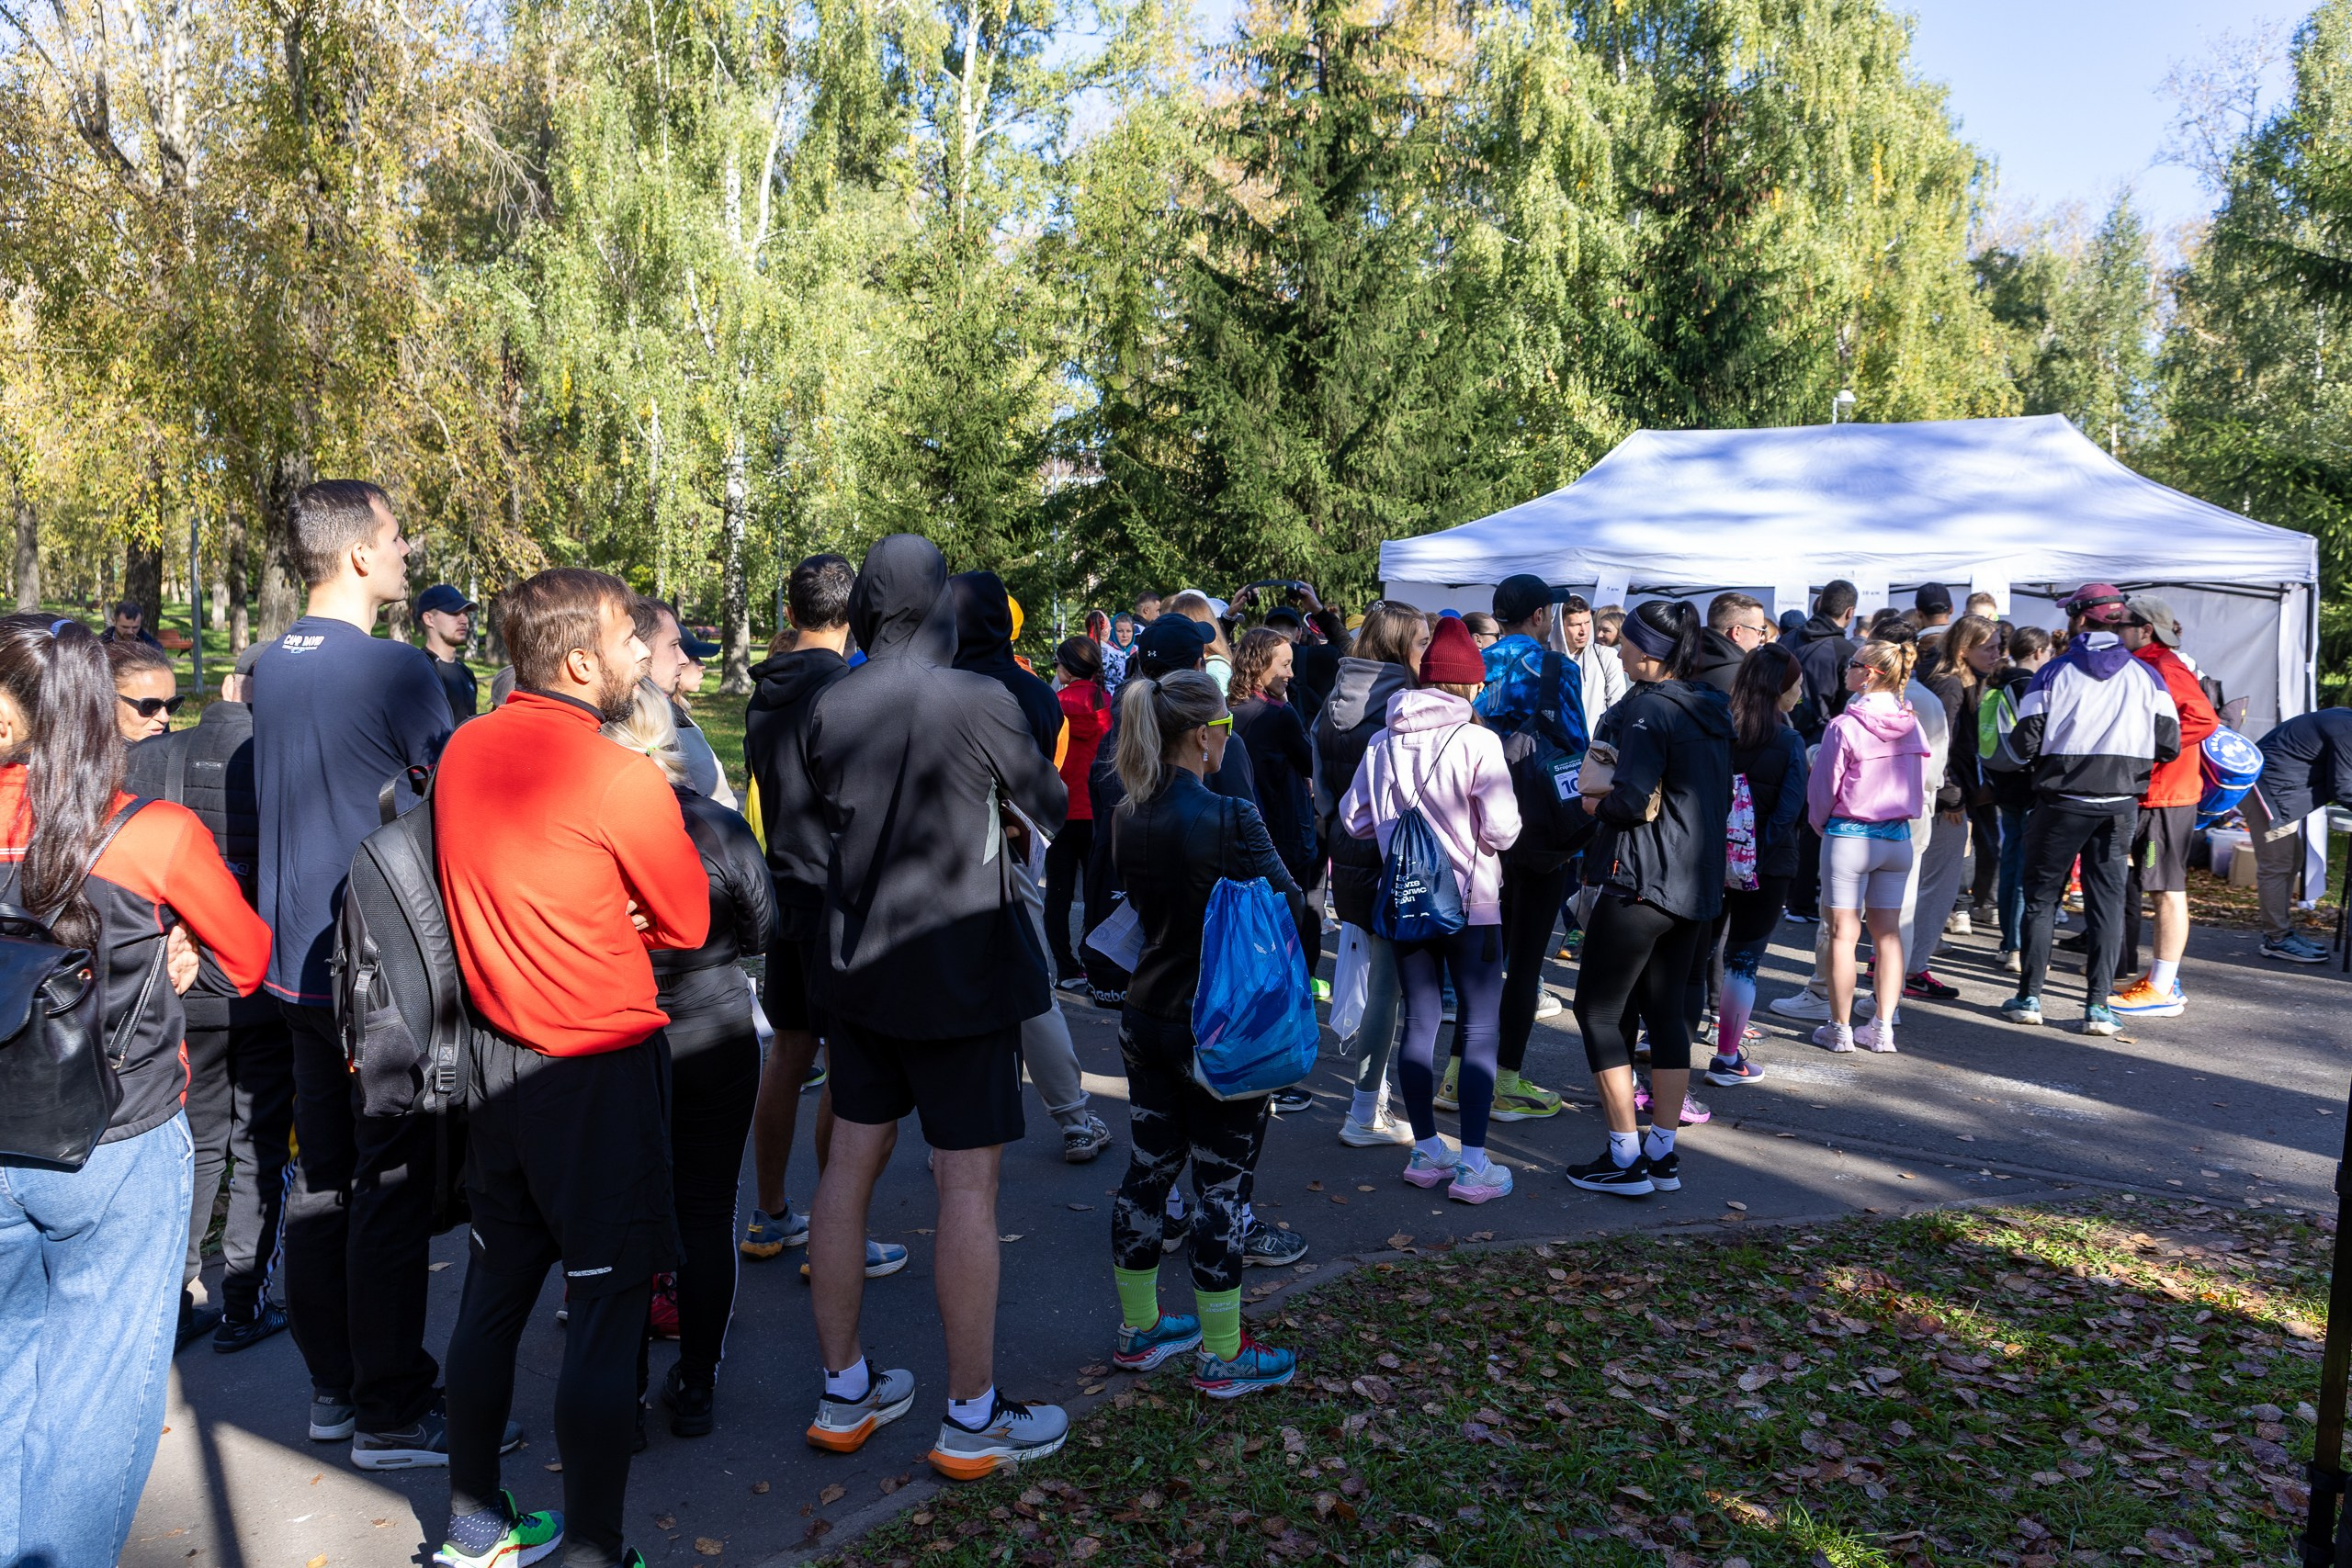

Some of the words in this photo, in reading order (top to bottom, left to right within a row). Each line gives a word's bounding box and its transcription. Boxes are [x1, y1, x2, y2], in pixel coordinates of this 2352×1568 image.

[284, 634, 303, 647] CAMP
[301, 636, 325, 647] DAVID
[1087, 982, 1128, 1002] Reebo
[317, 1395, 335, 1404] NIKE
